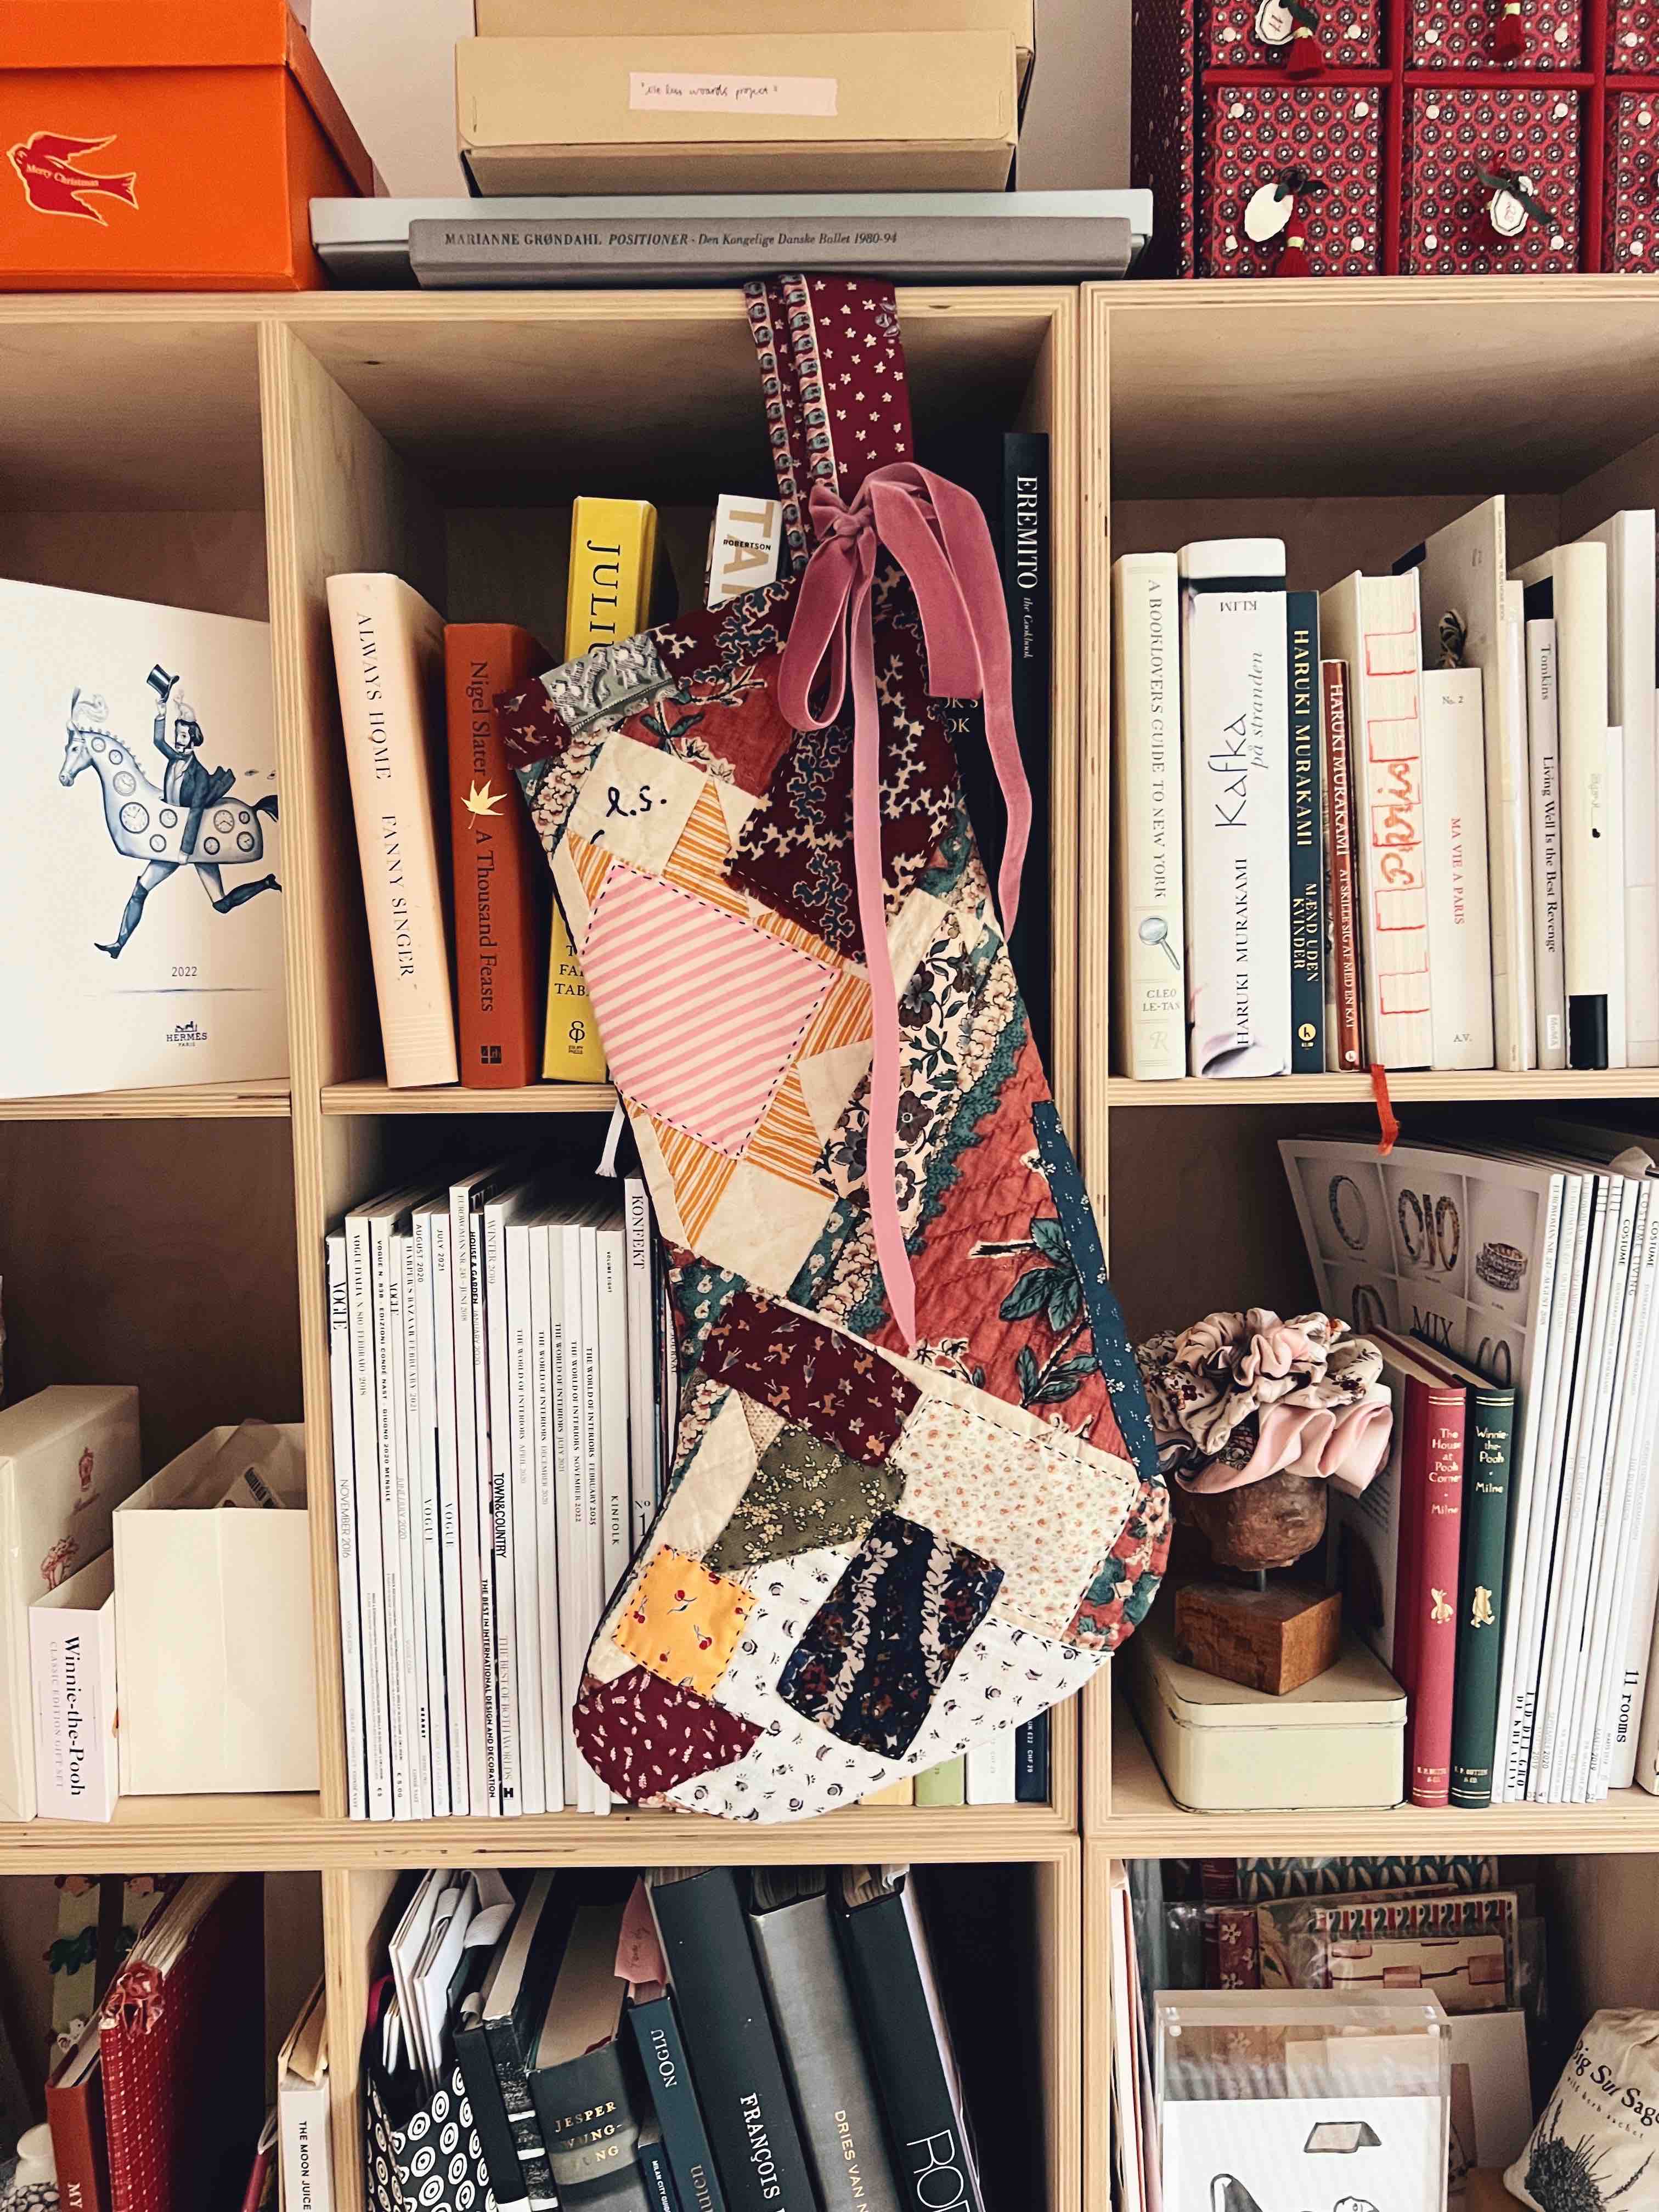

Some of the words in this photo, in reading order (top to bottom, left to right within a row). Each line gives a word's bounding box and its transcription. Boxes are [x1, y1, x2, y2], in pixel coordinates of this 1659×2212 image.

[26, 163, 52, 178] Merry
[54, 172, 99, 187] Christmas
[445, 233, 520, 245] MARIANNE
[524, 233, 602, 245] GRØNDAHL
[608, 233, 688, 245] POSITIONER
[698, 233, 719, 245] Den
[724, 233, 775, 248] Kongelige
[778, 233, 816, 244] Danske
[855, 232, 898, 244] 1980-94
[723, 539, 771, 551] ROBERTSON
[1017, 475, 1038, 589] EREMITO
[1023, 598, 1034, 612] the
[1149, 580, 1161, 591] A
[1220, 601, 1257, 612] KLIM
[356, 611, 382, 702] ALWAYS
[1023, 614, 1034, 658] Cookbook
[466, 660, 491, 713] Nigel
[1294, 630, 1310, 715] HARUKI
[1541, 643, 1553, 701] Tomkins
[1248, 651, 1264, 738] stranden
[1330, 684, 1344, 752] HARUKI
[369, 712, 391, 780] HOME
[470, 720, 491, 776] Slater
[1151, 719, 1164, 773] GUIDE
[1248, 744, 1269, 770] på
[1152, 781, 1165, 802] TO
[1207, 713, 1248, 828] Kafka
[1295, 724, 1312, 847] MURAKAMI
[1542, 757, 1555, 797] Living
[1153, 808, 1165, 847] NEW
[1333, 757, 1350, 856] MURAKAMI
[1544, 800, 1556, 828] Well
[475, 829, 495, 844] A
[1451, 817, 1462, 839] MA
[1545, 833, 1556, 843] Is
[381, 815, 404, 889] FANNY
[1452, 844, 1463, 868] VIE
[1545, 848, 1556, 867] the
[1154, 853, 1167, 900] YORK
[1546, 871, 1558, 897] Best
[476, 850, 498, 947] Thousand
[1234, 859, 1248, 962] MURAKAMI
[1453, 887, 1465, 925] PARIS
[391, 897, 415, 978] SINGER
[1293, 898, 1306, 970] KVINDER
[1341, 925, 1351, 943] SIG
[1545, 901, 1558, 953] Revenge
[171, 966, 198, 977] 2022
[1306, 939, 1319, 983] UDEN
[1343, 961, 1353, 988] MED
[478, 953, 499, 1012] Feasts
[1146, 988, 1177, 999] CLEO
[1344, 989, 1353, 1005] EN
[1142, 1001, 1180, 1012] LE-TAN
[1236, 973, 1249, 1045] HARUKI
[487, 1220, 496, 1262] WINTER
[632, 1196, 645, 1269] KONFEKT
[1618, 1219, 1630, 1266] COSTUME
[1646, 1221, 1659, 1269] COSTUME
[332, 1282, 347, 1330] VOGUE
[1412, 1305, 1453, 1347] MIX
[1431, 1438, 1462, 1450] House
[1439, 1427, 1459, 1439] The
[1428, 1471, 1462, 1482] Corner
[1435, 1460, 1459, 1472] Pooh
[1442, 1453, 1454, 1461] at
[1479, 1451, 1505, 1464] Pooh
[340, 1479, 351, 1536] NOVEMBER
[1475, 1481, 1504, 1493] Milne
[424, 1499, 434, 1545] VOGUE
[444, 1503, 455, 1549] VOGUE
[493, 1472, 507, 1558] TOWN&COUNTRY
[611, 1496, 619, 1545] KINFOLK
[1431, 1503, 1460, 1515] Milne
[340, 1537, 351, 1559] 2016
[483, 1618, 490, 1627] IN
[50, 1641, 59, 1685] CLASSIC
[483, 1629, 492, 1691] INTERNATIONAL
[52, 1690, 61, 1735] EDITION
[64, 1636, 86, 1796] Winnie-the-Pooh
[1616, 1694, 1633, 1743] rooms
[54, 1740, 63, 1765] GIFT
[487, 1746, 495, 1798] DECORATION
[55, 1768, 64, 1788] SET
[651, 2029, 678, 2088] NOGLU
[1590, 2064, 1622, 2096] Sur
[298, 2120, 308, 2141] THE
[555, 2101, 617, 2133] JESPER
[300, 2144, 309, 2177] MOON
[740, 2092, 781, 2199] FRANÇOIS
[834, 2109, 856, 2161] DRIES
[848, 2164, 865, 2198] VAN
[67, 2182, 83, 2208] MY
[302, 2180, 312, 2211] JUICE
[652, 2160, 662, 2180] MILAN
[657, 2180, 667, 2195] CITY
